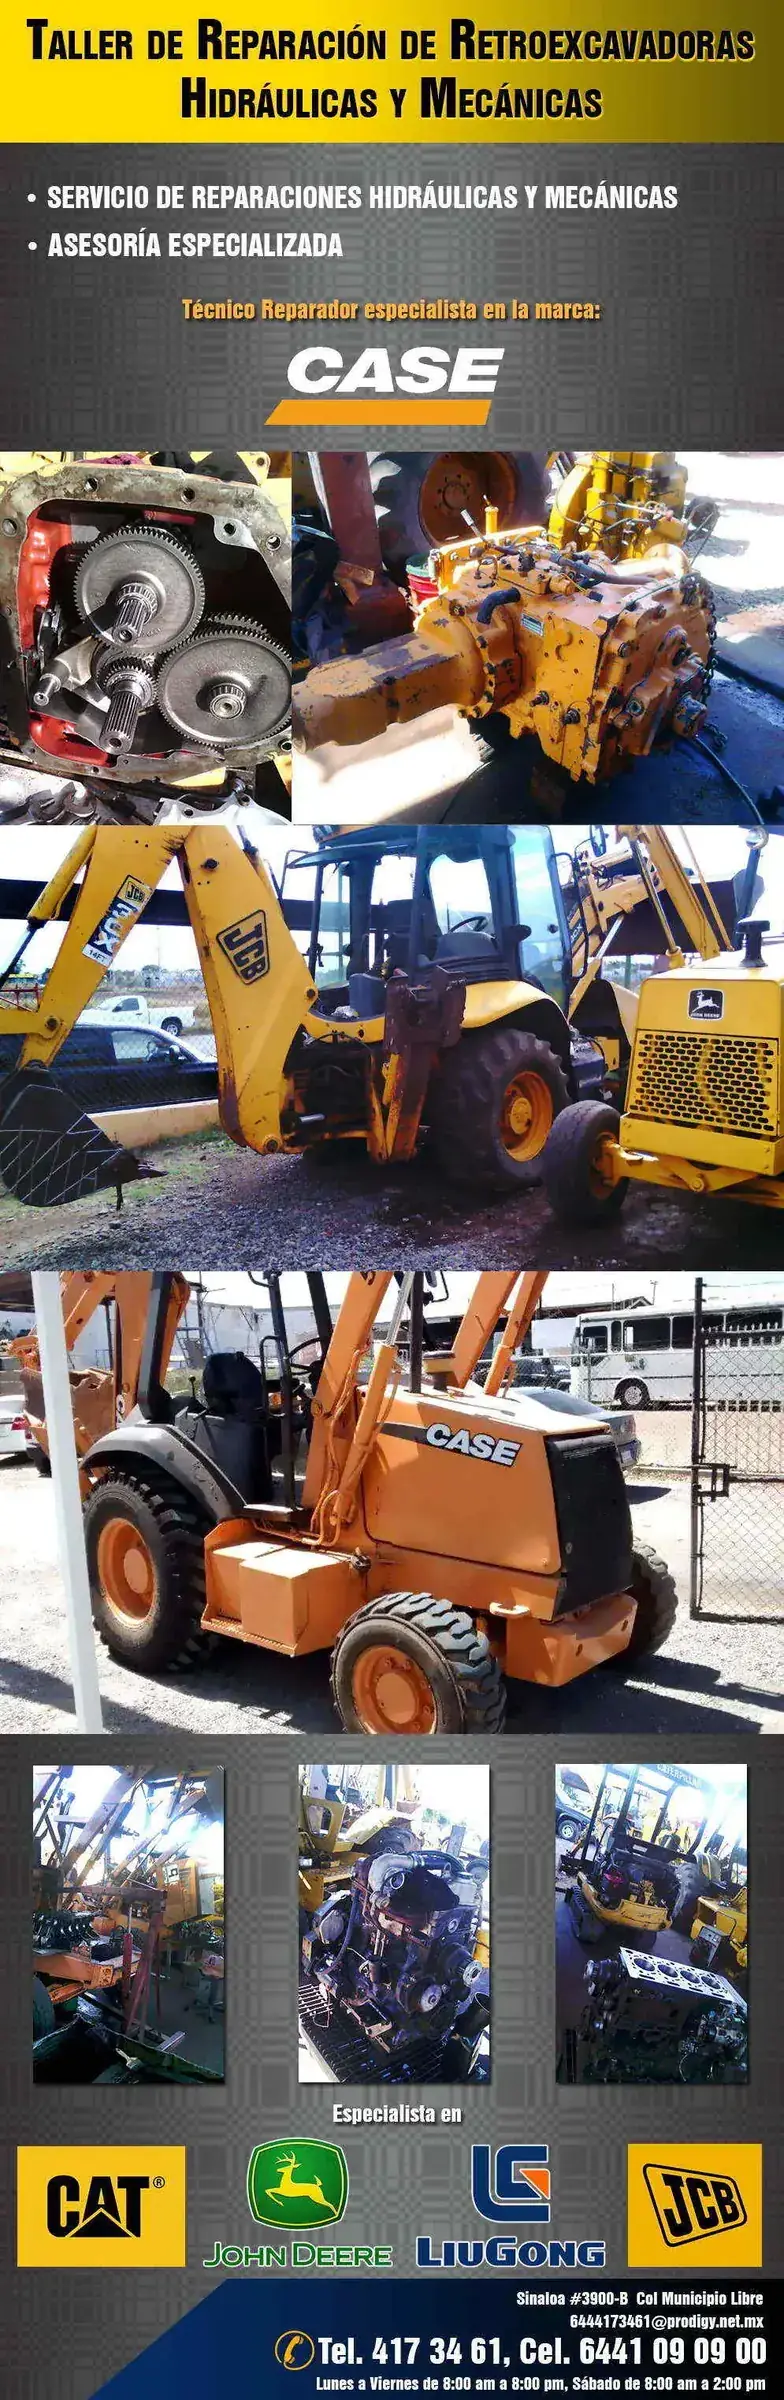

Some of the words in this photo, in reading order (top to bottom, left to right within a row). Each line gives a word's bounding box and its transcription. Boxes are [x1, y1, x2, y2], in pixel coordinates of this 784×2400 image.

[47, 186, 149, 209] SERVICIO
[156, 186, 185, 209] DE
[192, 186, 362, 209] REPARACIONES
[369, 182, 518, 209] HIDRÁULICAS
[525, 186, 538, 209] Y
[545, 182, 678, 209] MECÁNICAS
[48, 229, 161, 256] ASESORÍA
[168, 233, 343, 257] ESPECIALIZADA
[183, 299, 254, 319] Técnico
[262, 300, 357, 320] Reparador
[364, 300, 476, 320] especialista
[483, 304, 505, 318] en
[512, 301, 528, 318] la
[535, 303, 600, 318] marca:
[287, 347, 504, 393] CASE
[127, 884, 145, 901] JCB
[222, 922, 266, 981] JCB
[425, 1422, 522, 1467] CASE
[332, 2103, 436, 2125] Especialista
[441, 2108, 462, 2123] en
[661, 2173, 740, 2237] JCB
[203, 2242, 286, 2268] JOHN
[292, 2242, 393, 2268] DEERE
[516, 2291, 566, 2306] Sinaloa
[570, 2291, 629, 2306] #3900-B
[636, 2291, 658, 2306] Col
[662, 2291, 727, 2307] Municipio
[730, 2291, 764, 2306] Libre
[570, 2313, 764, 2331] 6444173461@prodigy.net.mx
[318, 2338, 363, 2365] Tel.
[372, 2337, 421, 2365] 417
[429, 2337, 463, 2365] 34
[470, 2337, 509, 2368] 61,
[519, 2337, 570, 2365] Cel.
[579, 2337, 641, 2365] 6441
[653, 2337, 685, 2365] 09
[694, 2337, 726, 2365] 09
[735, 2337, 767, 2365] 00
[316, 2377, 355, 2391] Lunes
[359, 2380, 366, 2391] a
[370, 2376, 419, 2391] Viernes
[422, 2377, 439, 2391] de
[442, 2377, 472, 2391] 8:00
[476, 2380, 496, 2391] am
[500, 2380, 508, 2391] a
[511, 2377, 540, 2391] 8:00
[545, 2380, 569, 2393] pm,
[572, 2375, 621, 2391] Sábado
[625, 2377, 641, 2391] de
[644, 2377, 673, 2391] 8:00
[677, 2380, 697, 2391] am
[701, 2380, 709, 2391] a
[712, 2377, 742, 2391] 2:00
[746, 2380, 766, 2393] pm
